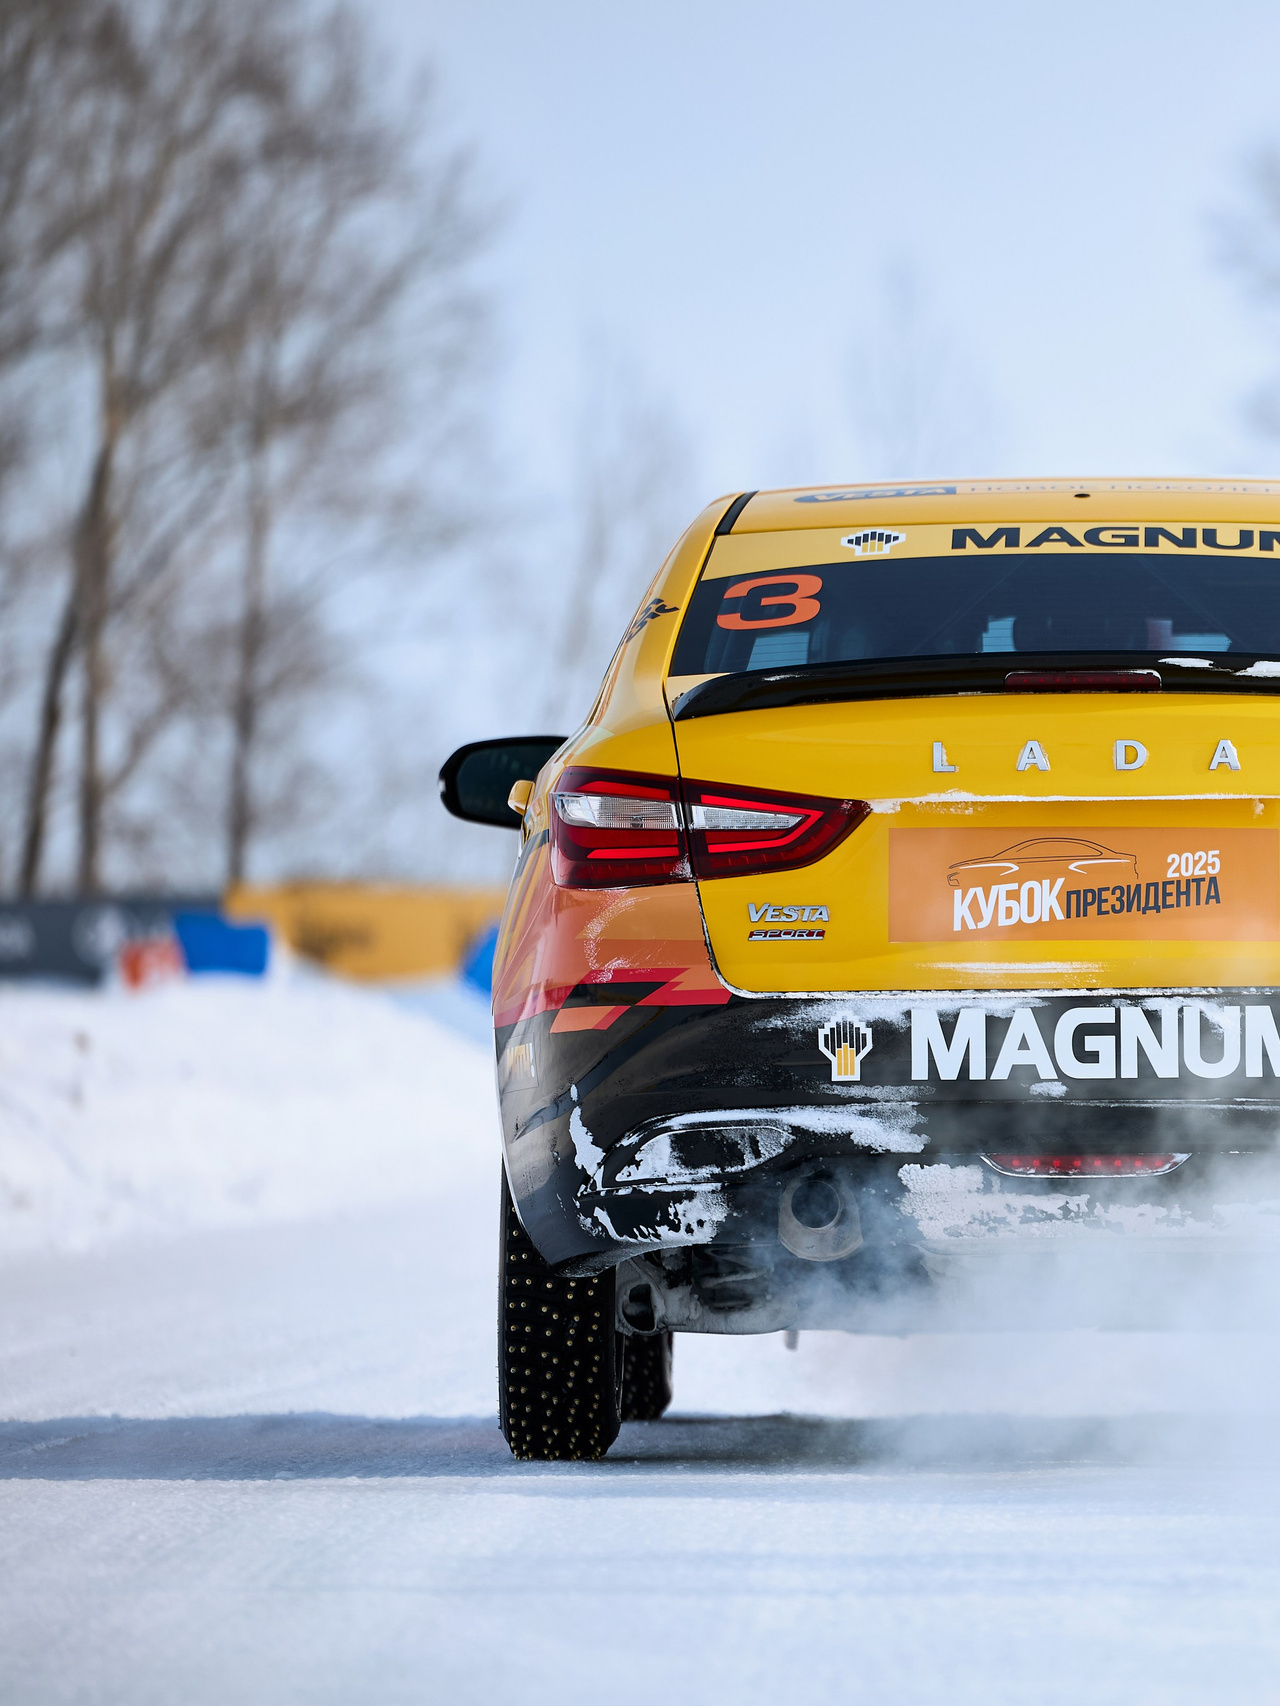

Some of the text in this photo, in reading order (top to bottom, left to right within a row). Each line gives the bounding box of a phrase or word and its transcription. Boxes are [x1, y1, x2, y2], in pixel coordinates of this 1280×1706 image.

[716, 574, 823, 630] 3
[932, 740, 1241, 773] LADA
[1166, 850, 1221, 878] 2025
[748, 903, 829, 922] VESTA
[953, 876, 1221, 931] КУБОК ПРЕЗИДЕНТА
[749, 929, 825, 941] SPORT
